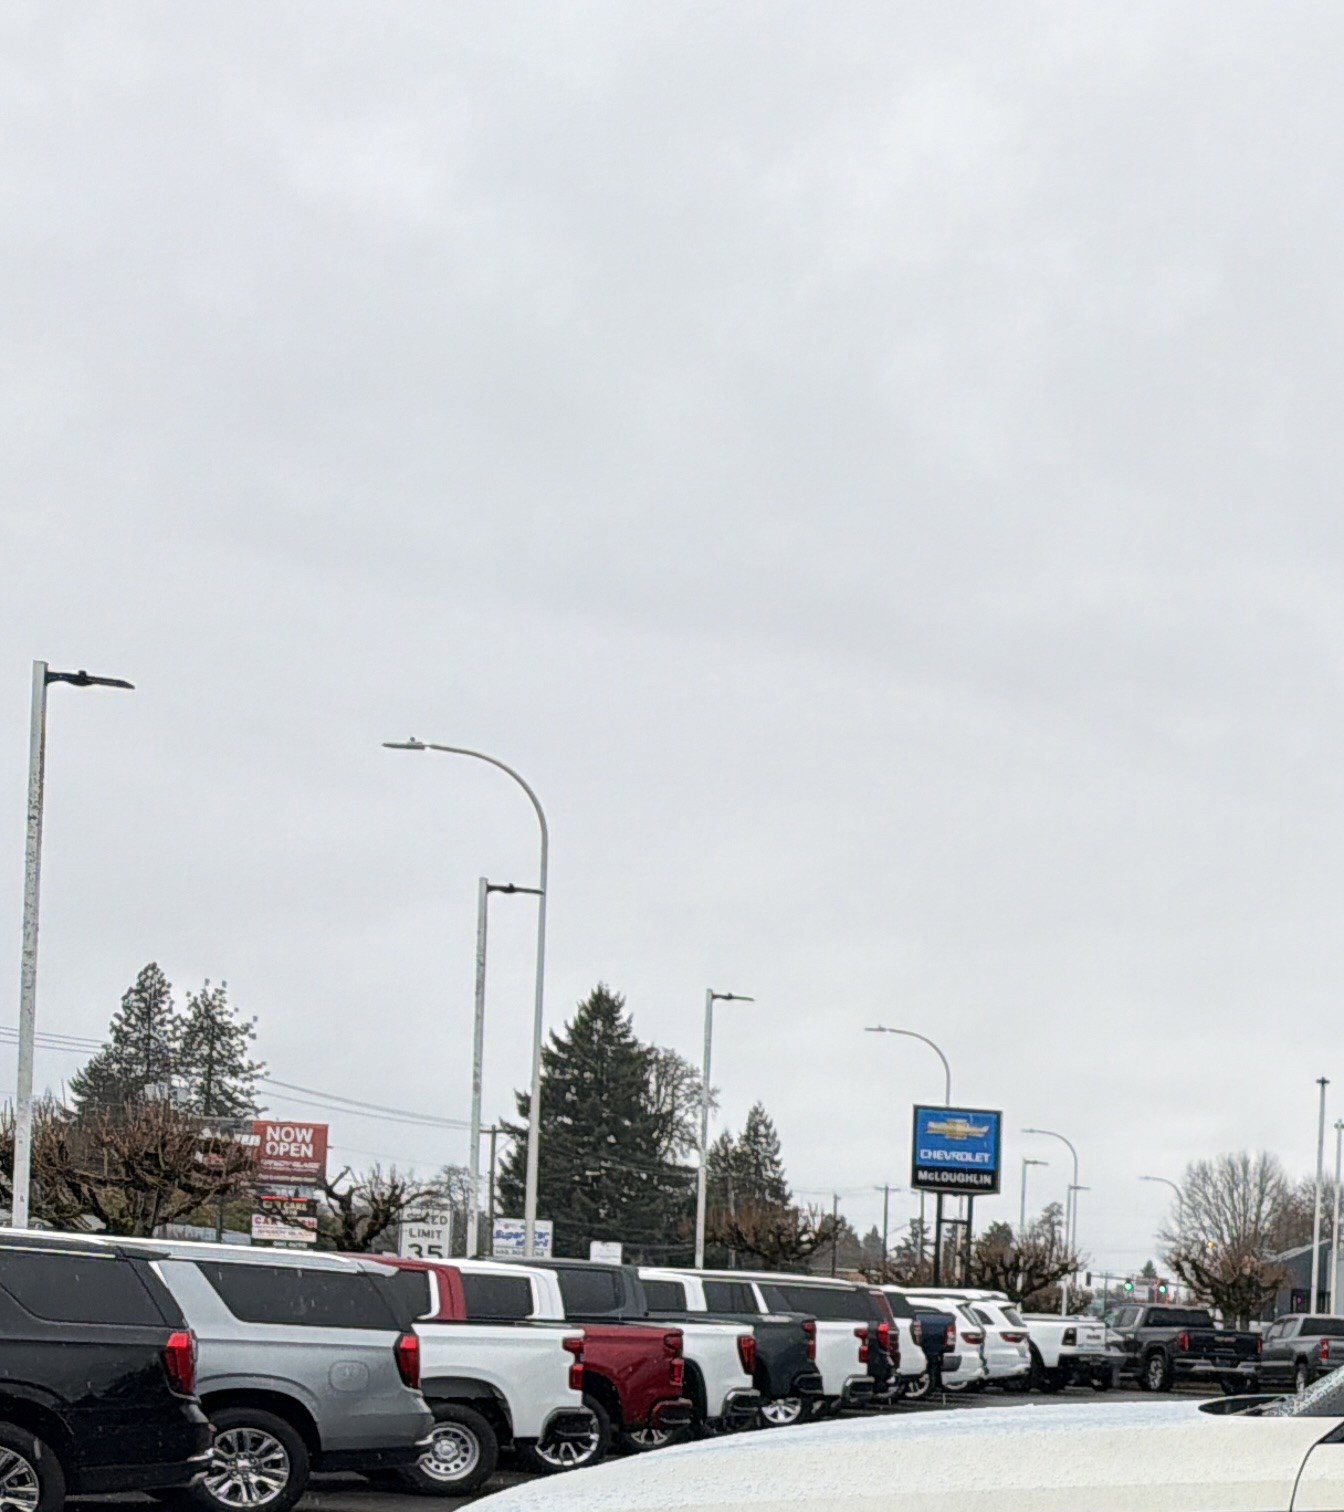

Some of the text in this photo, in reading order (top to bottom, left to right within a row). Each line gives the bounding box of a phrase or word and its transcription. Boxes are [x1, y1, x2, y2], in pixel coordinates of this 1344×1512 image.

[265, 1125, 313, 1143] NOW
[265, 1142, 314, 1158] OPEN
[920, 1149, 990, 1162] CHEVROLET
[918, 1170, 992, 1184] McLOUGHLIN
[407, 1212, 448, 1225] SPED
[408, 1227, 443, 1240] LIMIT
[407, 1243, 444, 1259] 35
